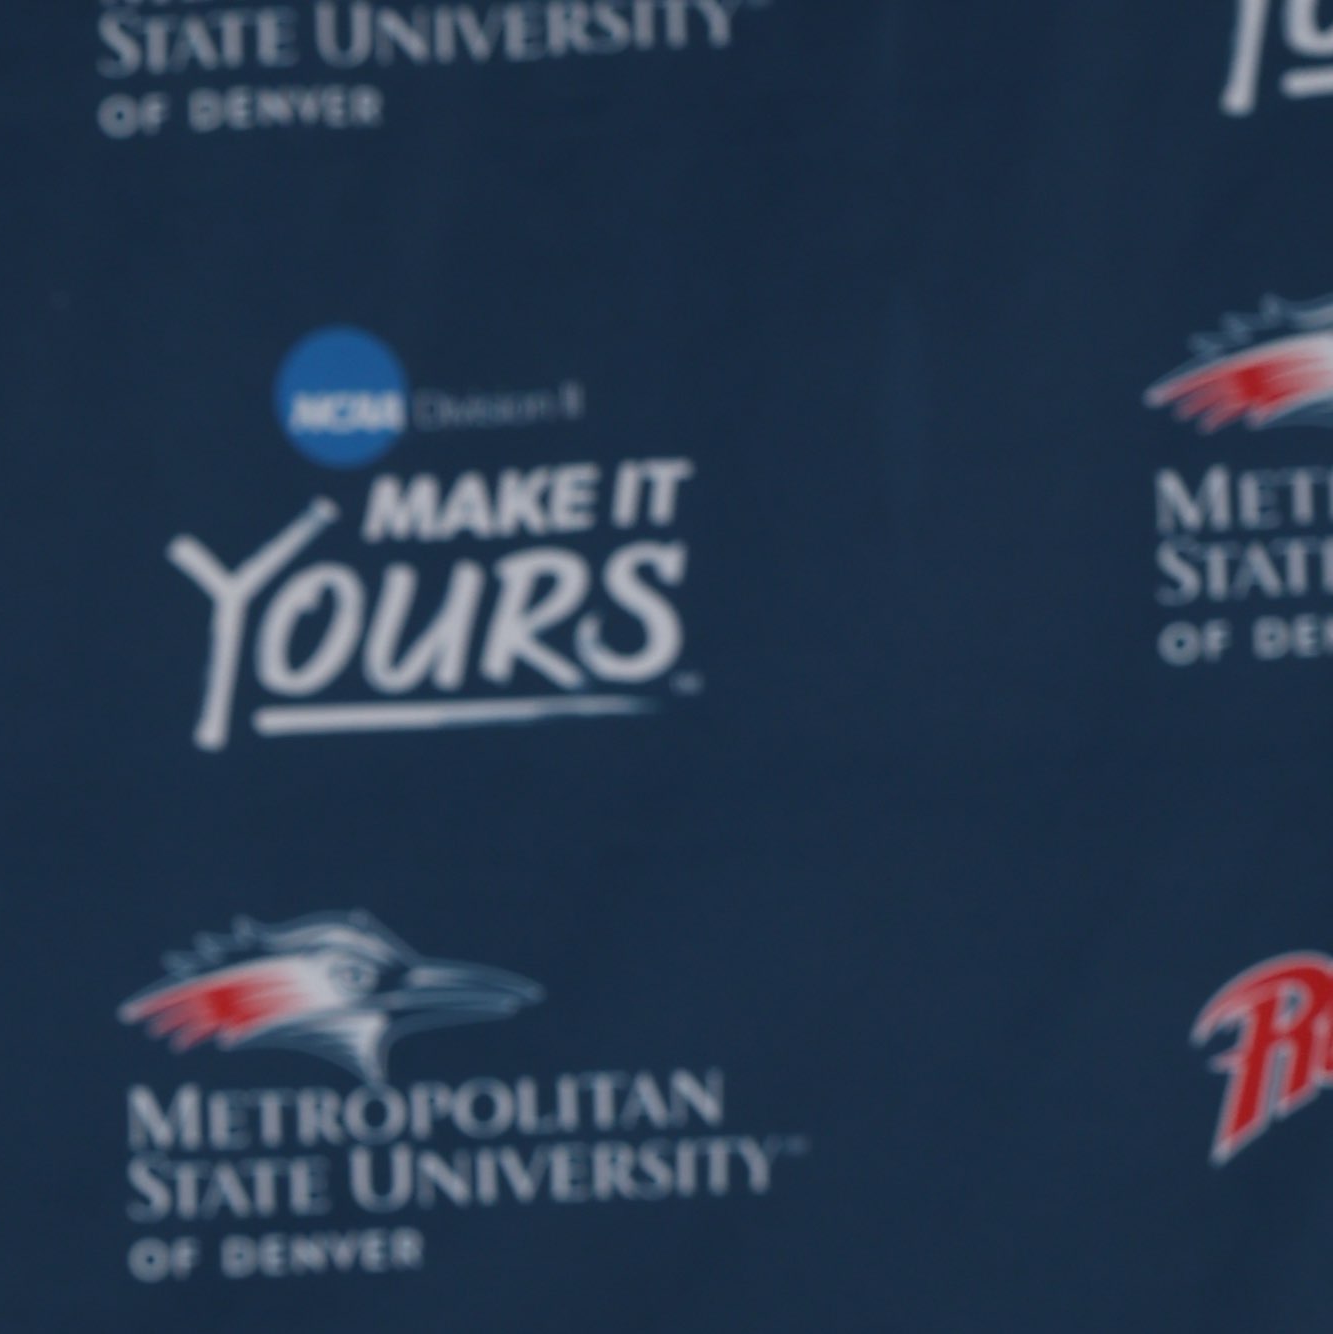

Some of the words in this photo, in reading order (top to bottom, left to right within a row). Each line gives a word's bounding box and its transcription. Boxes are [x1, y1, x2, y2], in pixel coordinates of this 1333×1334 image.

[96, 9, 301, 79] STATE
[316, 0, 731, 68] UNIVERSITY
[96, 90, 167, 139] OF
[188, 85, 383, 131] DENVER
[362, 463, 601, 542] MAKE
[611, 456, 695, 527] IT
[1155, 465, 1333, 533] MET
[1154, 539, 1333, 606] STAT
[167, 496, 688, 750] YOURS
[1155, 620, 1231, 666] OF
[1252, 614, 1333, 661] DE
[129, 1067, 723, 1150] METROPOLITAN
[129, 1153, 331, 1222] STATE
[347, 1136, 772, 1213] UNIVERSITY
[129, 1235, 202, 1283] OF
[219, 1226, 427, 1280] DENVER
